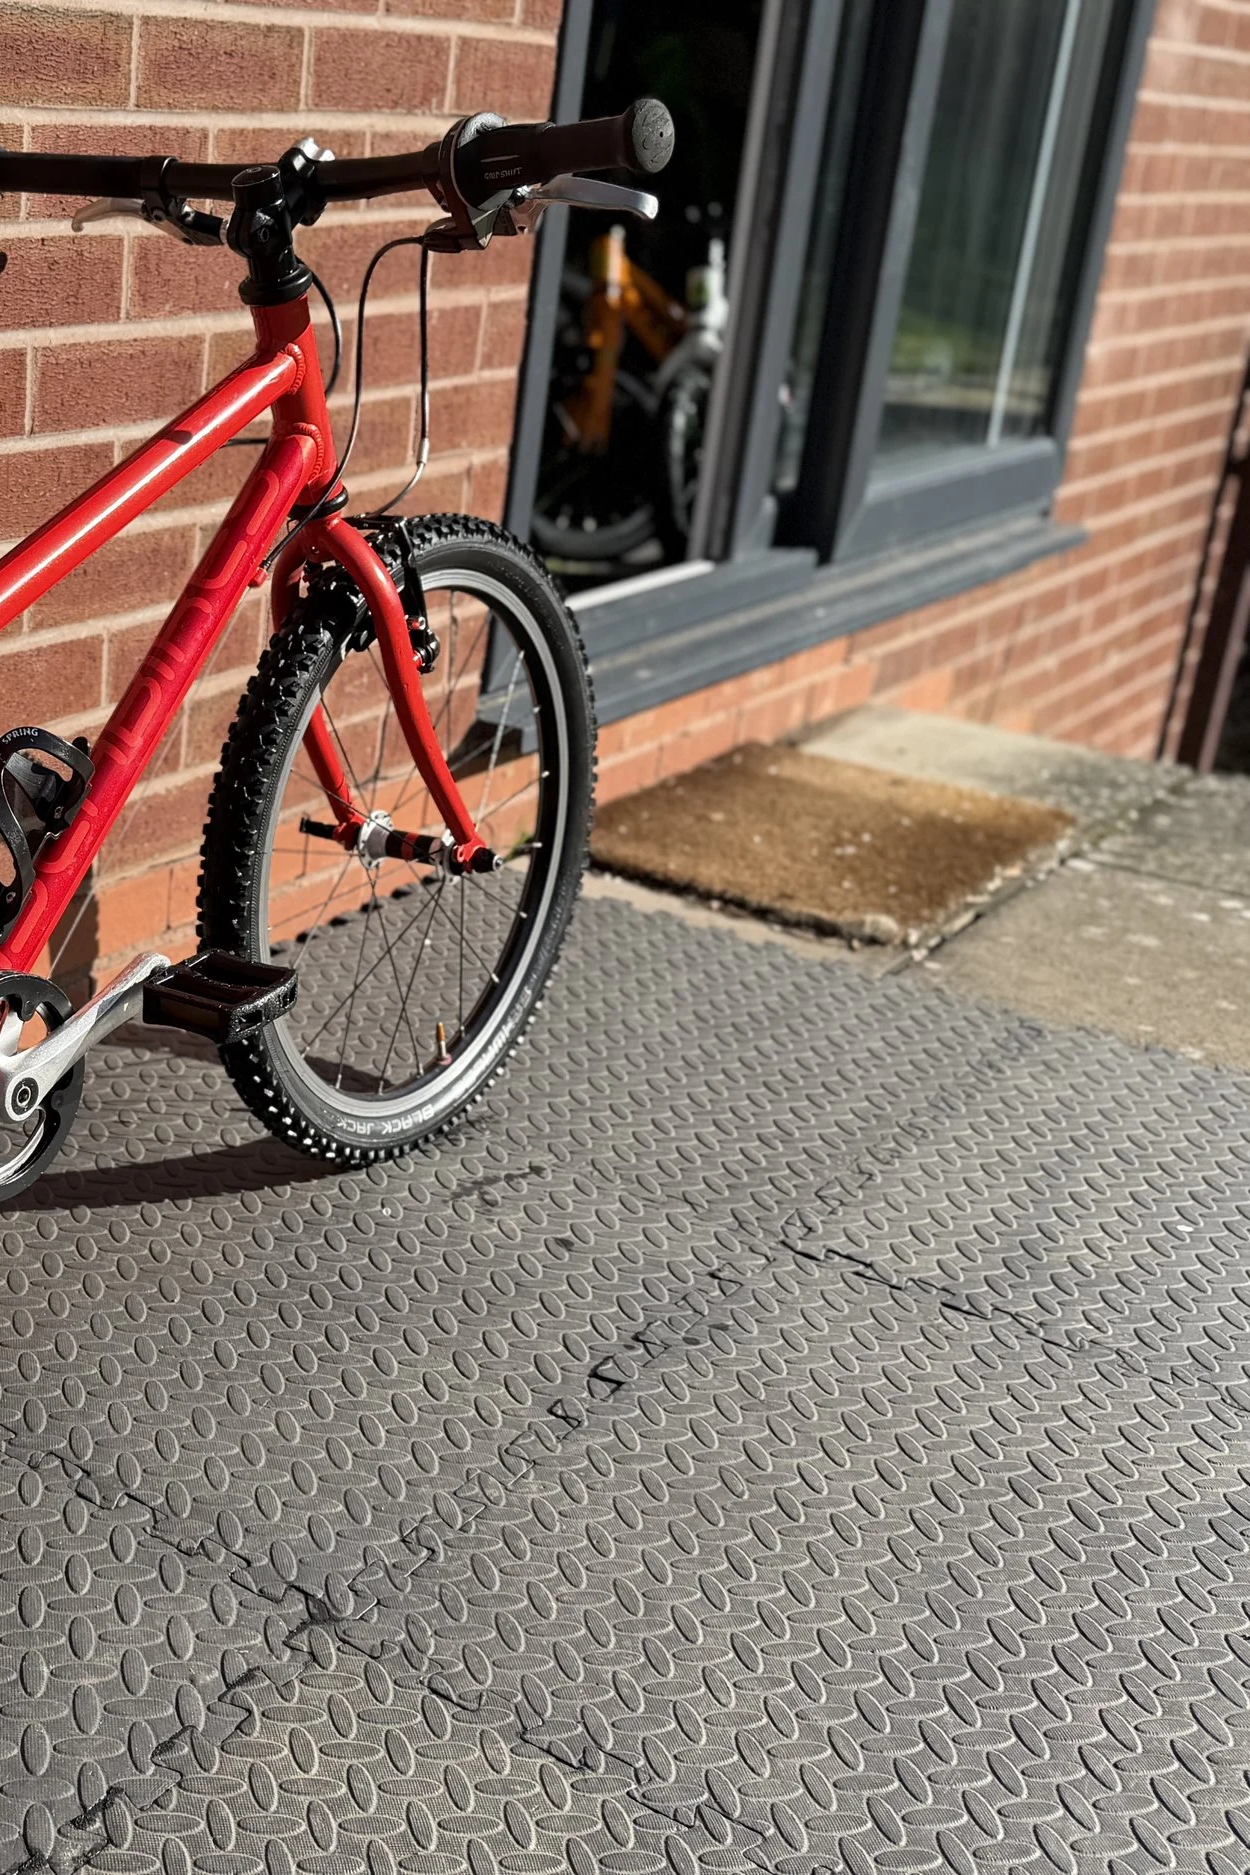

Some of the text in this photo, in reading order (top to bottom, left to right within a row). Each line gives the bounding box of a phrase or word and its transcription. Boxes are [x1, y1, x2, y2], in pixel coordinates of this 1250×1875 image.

[2, 728, 39, 745] SPRING
[337, 1103, 435, 1135] BLACK JACK
